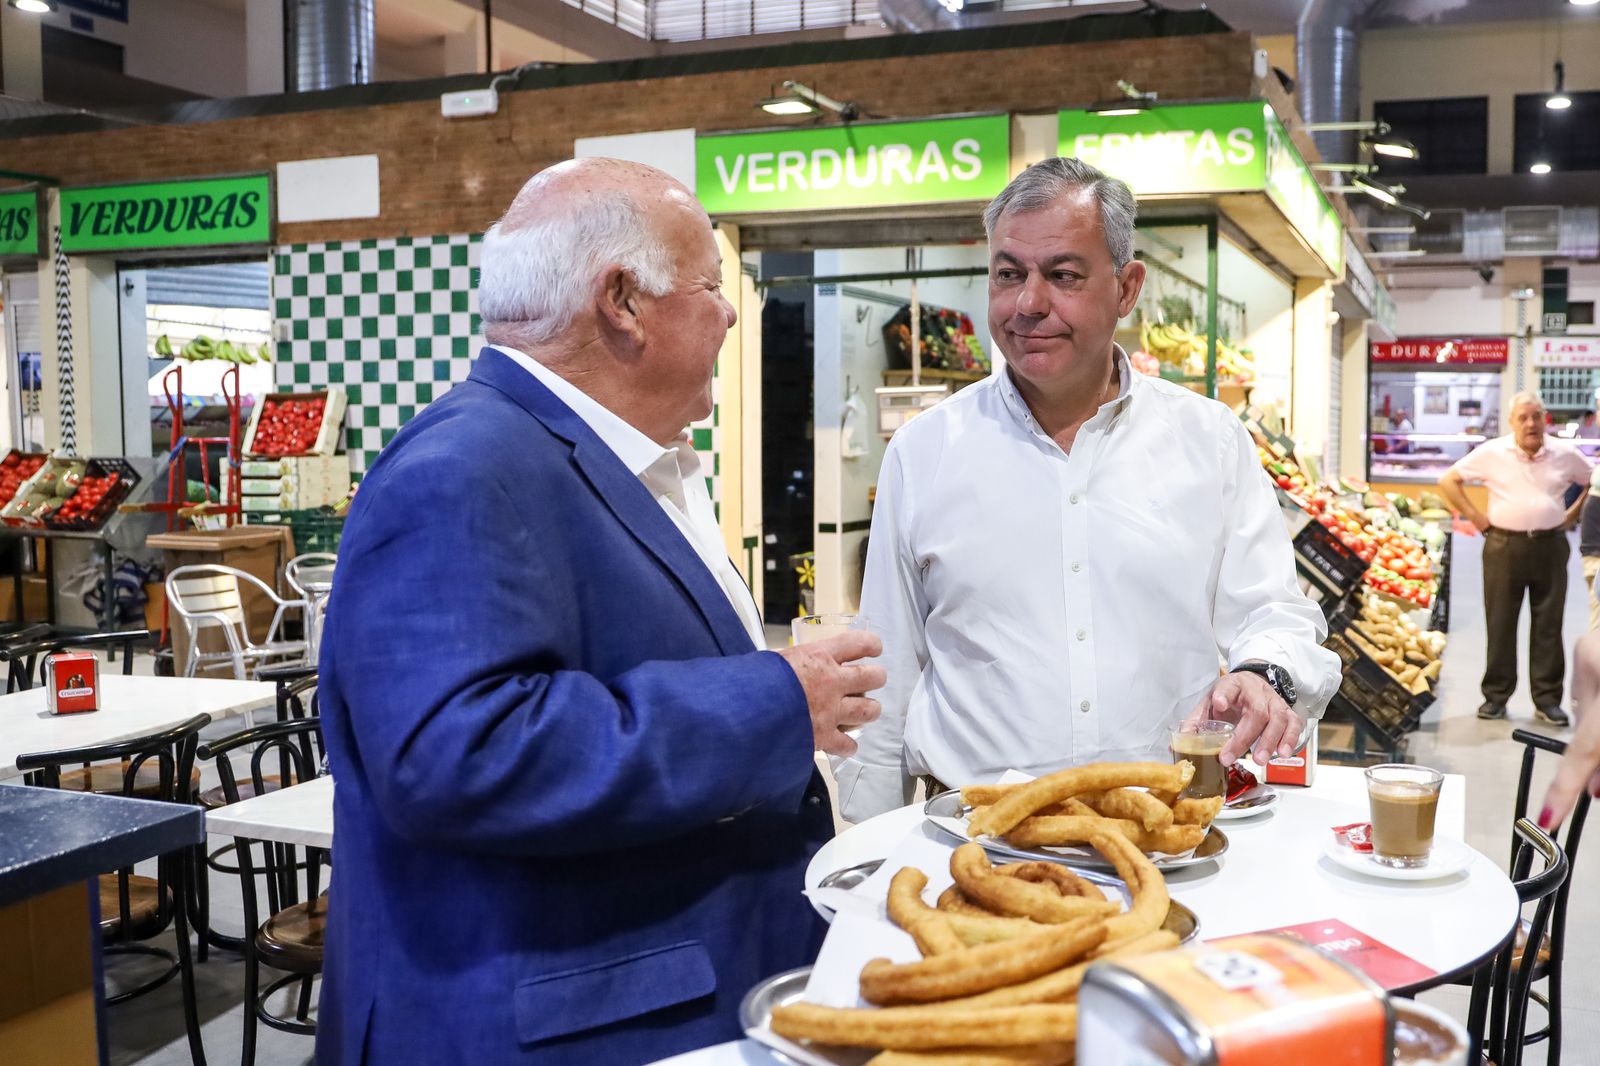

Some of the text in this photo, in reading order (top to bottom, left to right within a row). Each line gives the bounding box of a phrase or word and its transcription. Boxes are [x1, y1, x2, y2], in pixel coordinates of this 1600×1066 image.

[714, 138, 983, 195] VERDURAS
[0, 206, 31, 242] AS
[69, 191, 260, 237] VERDURAS
